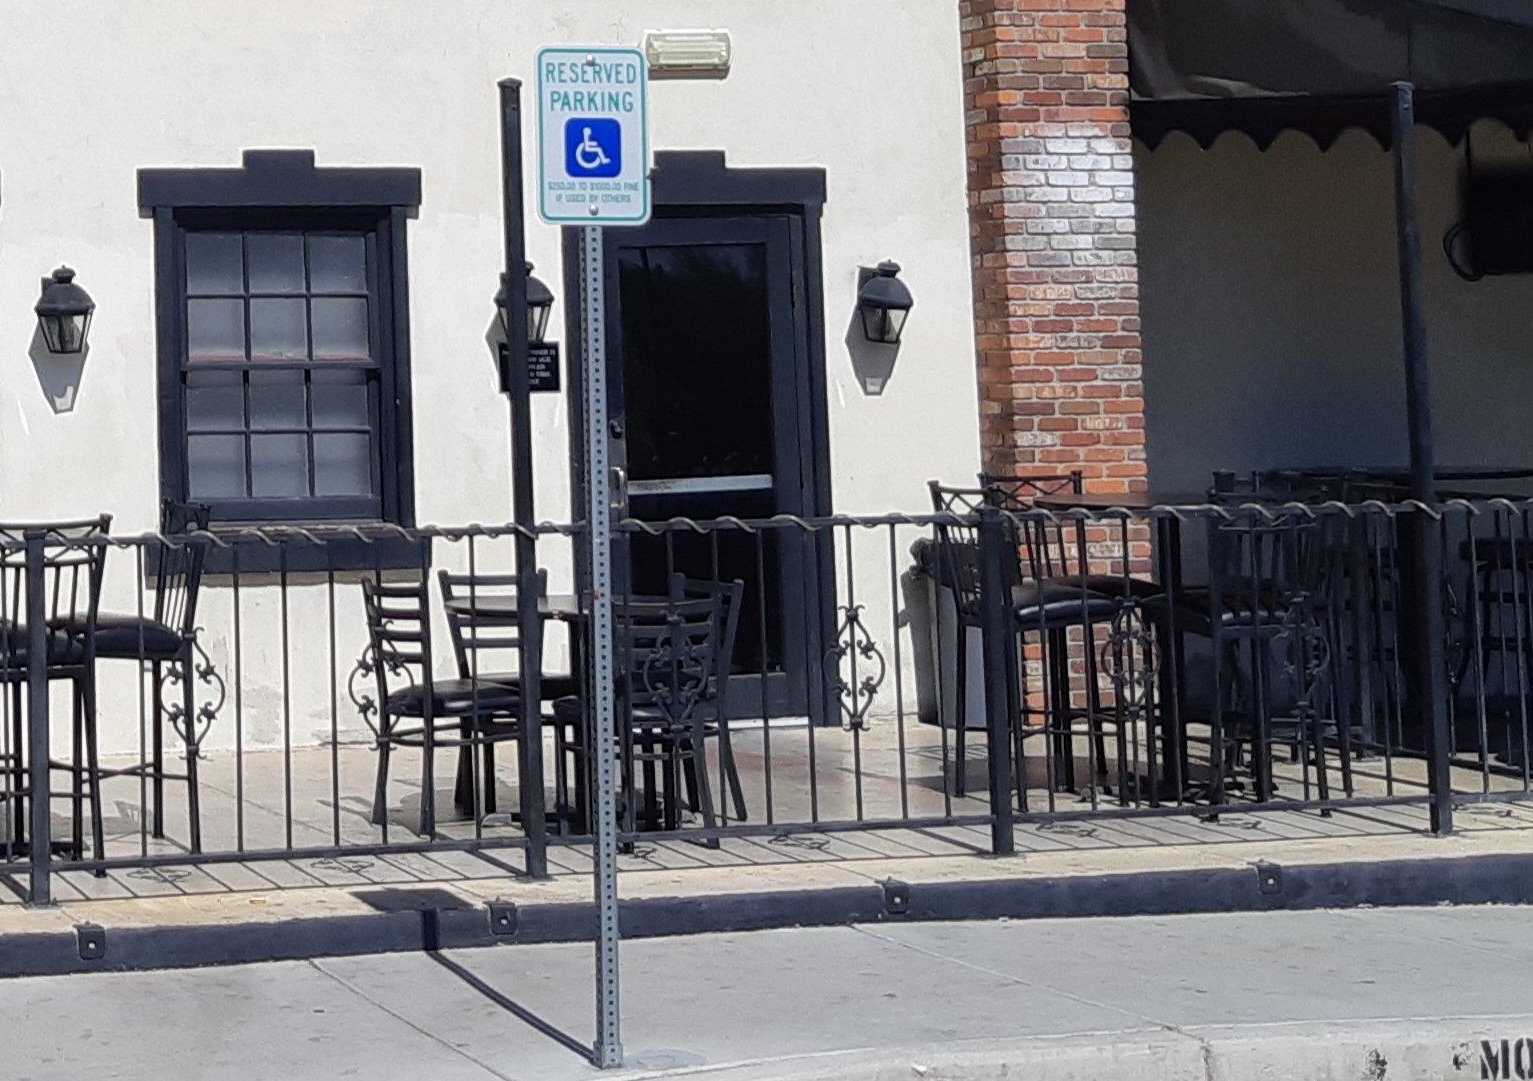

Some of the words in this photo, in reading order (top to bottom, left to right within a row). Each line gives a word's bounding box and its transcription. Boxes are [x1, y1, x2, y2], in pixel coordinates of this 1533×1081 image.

[545, 62, 637, 84] RESERVED
[550, 90, 634, 112] PARKING
[578, 182, 587, 191] TO
[566, 194, 586, 202] USED
[589, 194, 598, 203] BY
[601, 194, 631, 203] OTHERS
